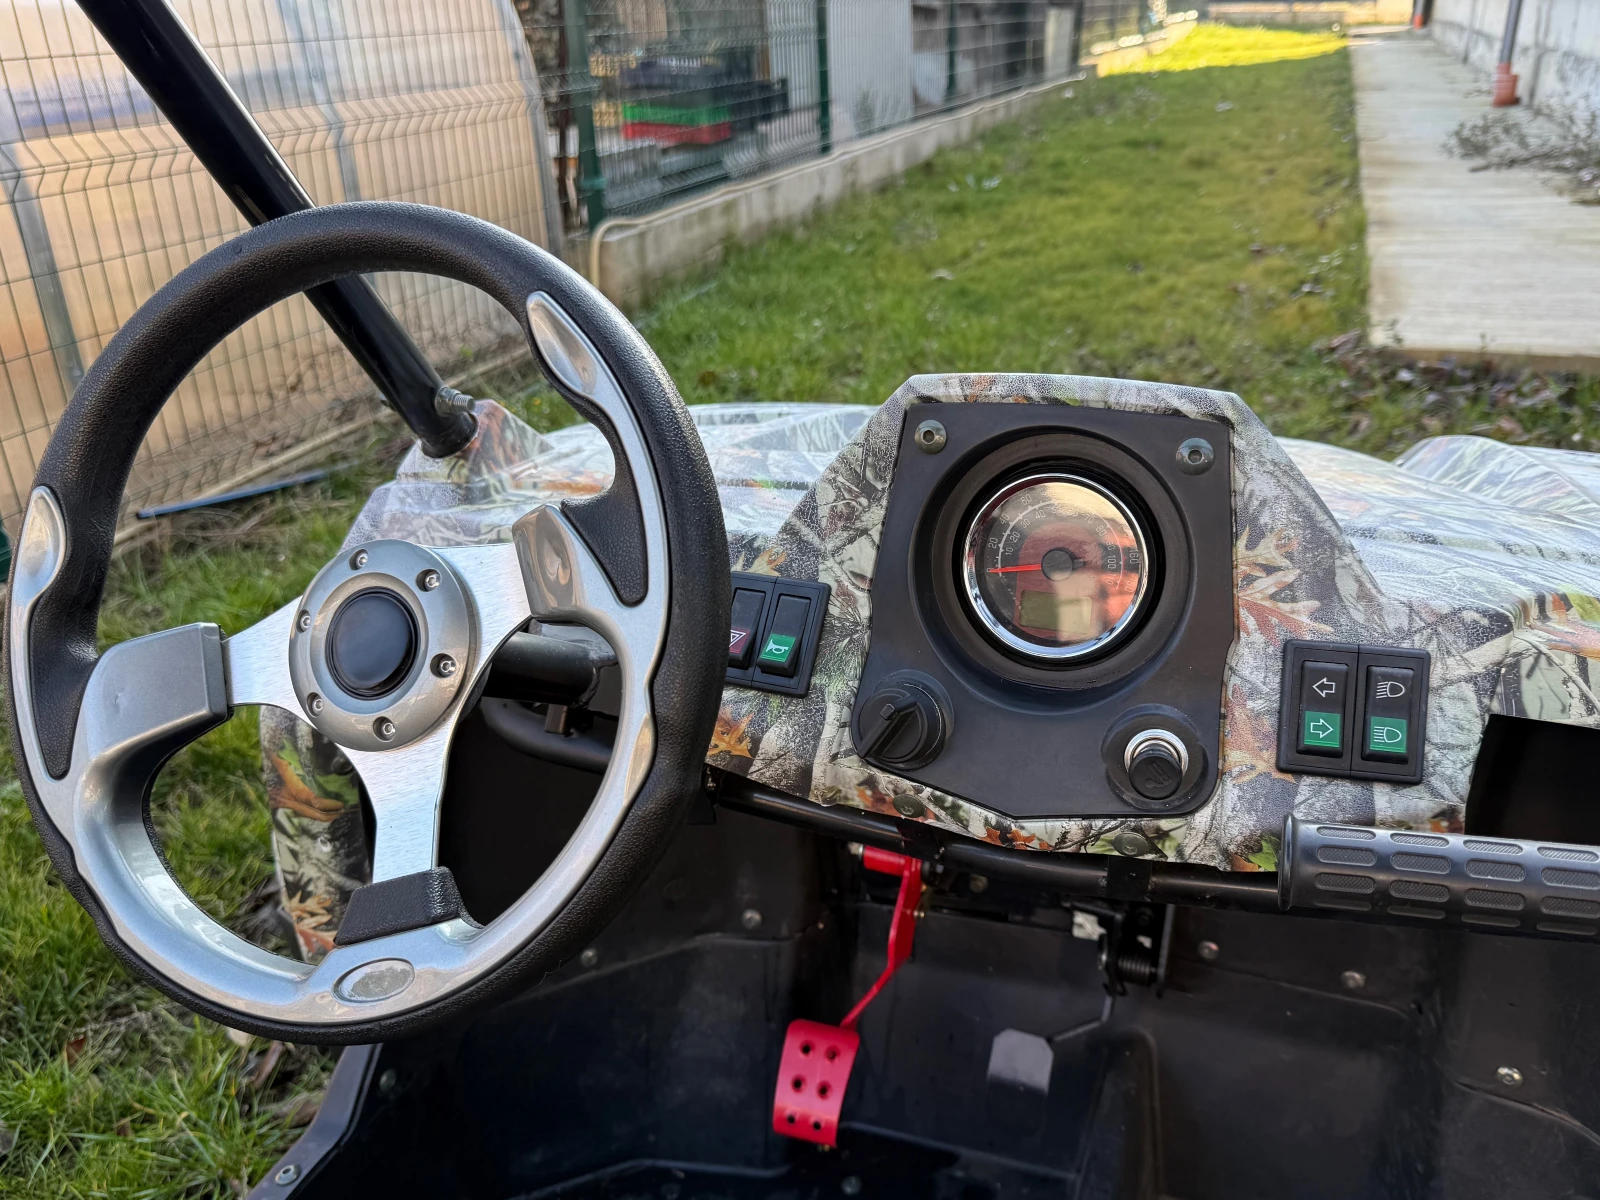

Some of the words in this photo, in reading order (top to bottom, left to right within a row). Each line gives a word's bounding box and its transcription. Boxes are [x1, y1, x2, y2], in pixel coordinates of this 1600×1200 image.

[1020, 493, 1032, 505] 60
[1000, 512, 1010, 525] 40
[1035, 509, 1046, 519] 40
[1020, 518, 1031, 529] 30
[987, 537, 999, 549] 20
[1009, 531, 1021, 543] 20
[1005, 546, 1014, 555] 10
[1107, 554, 1117, 569] 100
